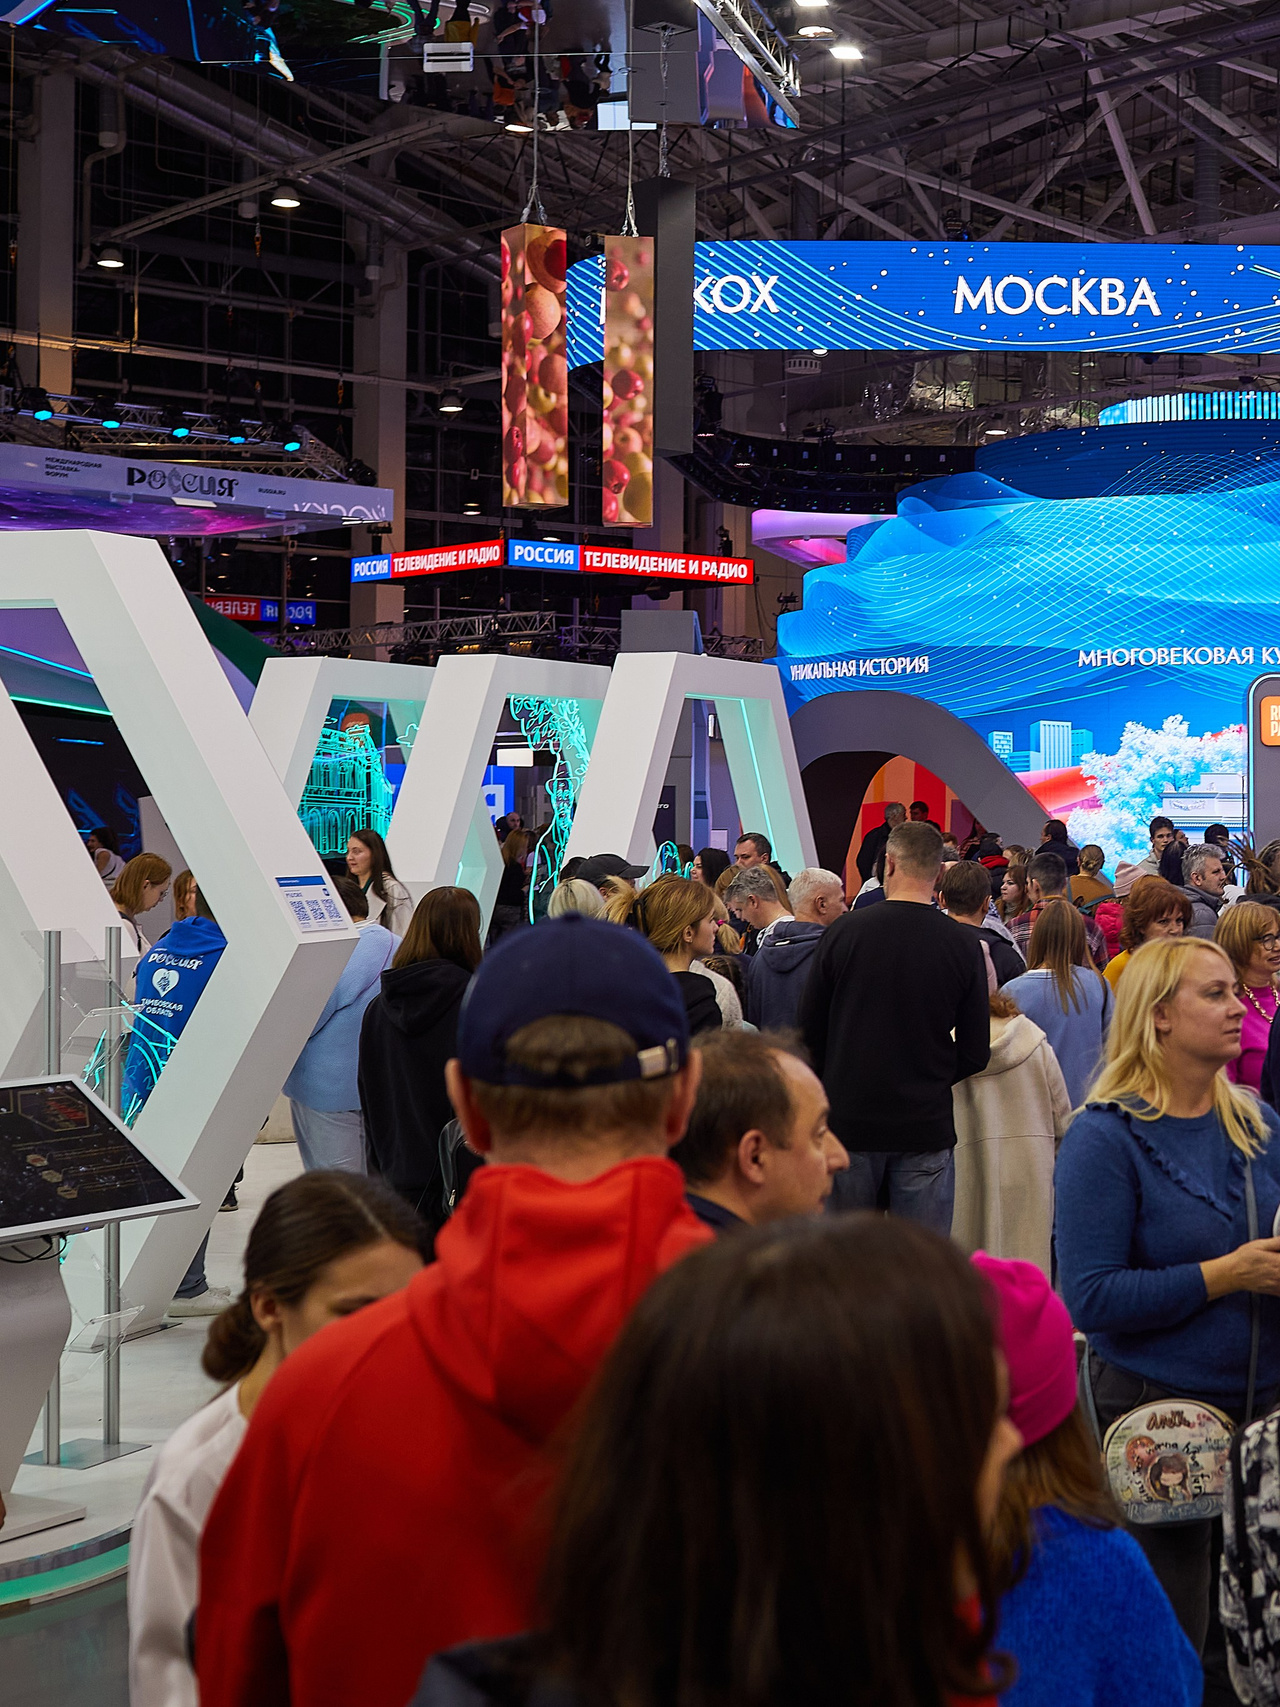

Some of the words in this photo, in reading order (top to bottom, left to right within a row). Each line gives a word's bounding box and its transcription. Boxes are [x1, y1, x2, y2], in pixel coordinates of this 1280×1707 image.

[953, 275, 1161, 316] МОСКВА
[354, 559, 388, 577] РОССИЯ
[393, 550, 457, 573] ТЕЛЕВИДЕНИЕ
[458, 552, 466, 565] И
[466, 545, 500, 565] РАДИО
[514, 545, 574, 565] РОССИЯ
[584, 550, 686, 574] ТЕЛЕВИДЕНИЕ
[688, 559, 699, 574] И
[701, 560, 748, 579] РАДИО
[790, 660, 856, 681] УНИКАЛЬНАЯ
[859, 656, 929, 676] ИСТОРИЯ
[1078, 647, 1254, 667] МНОГОВЕКОВАЯ
